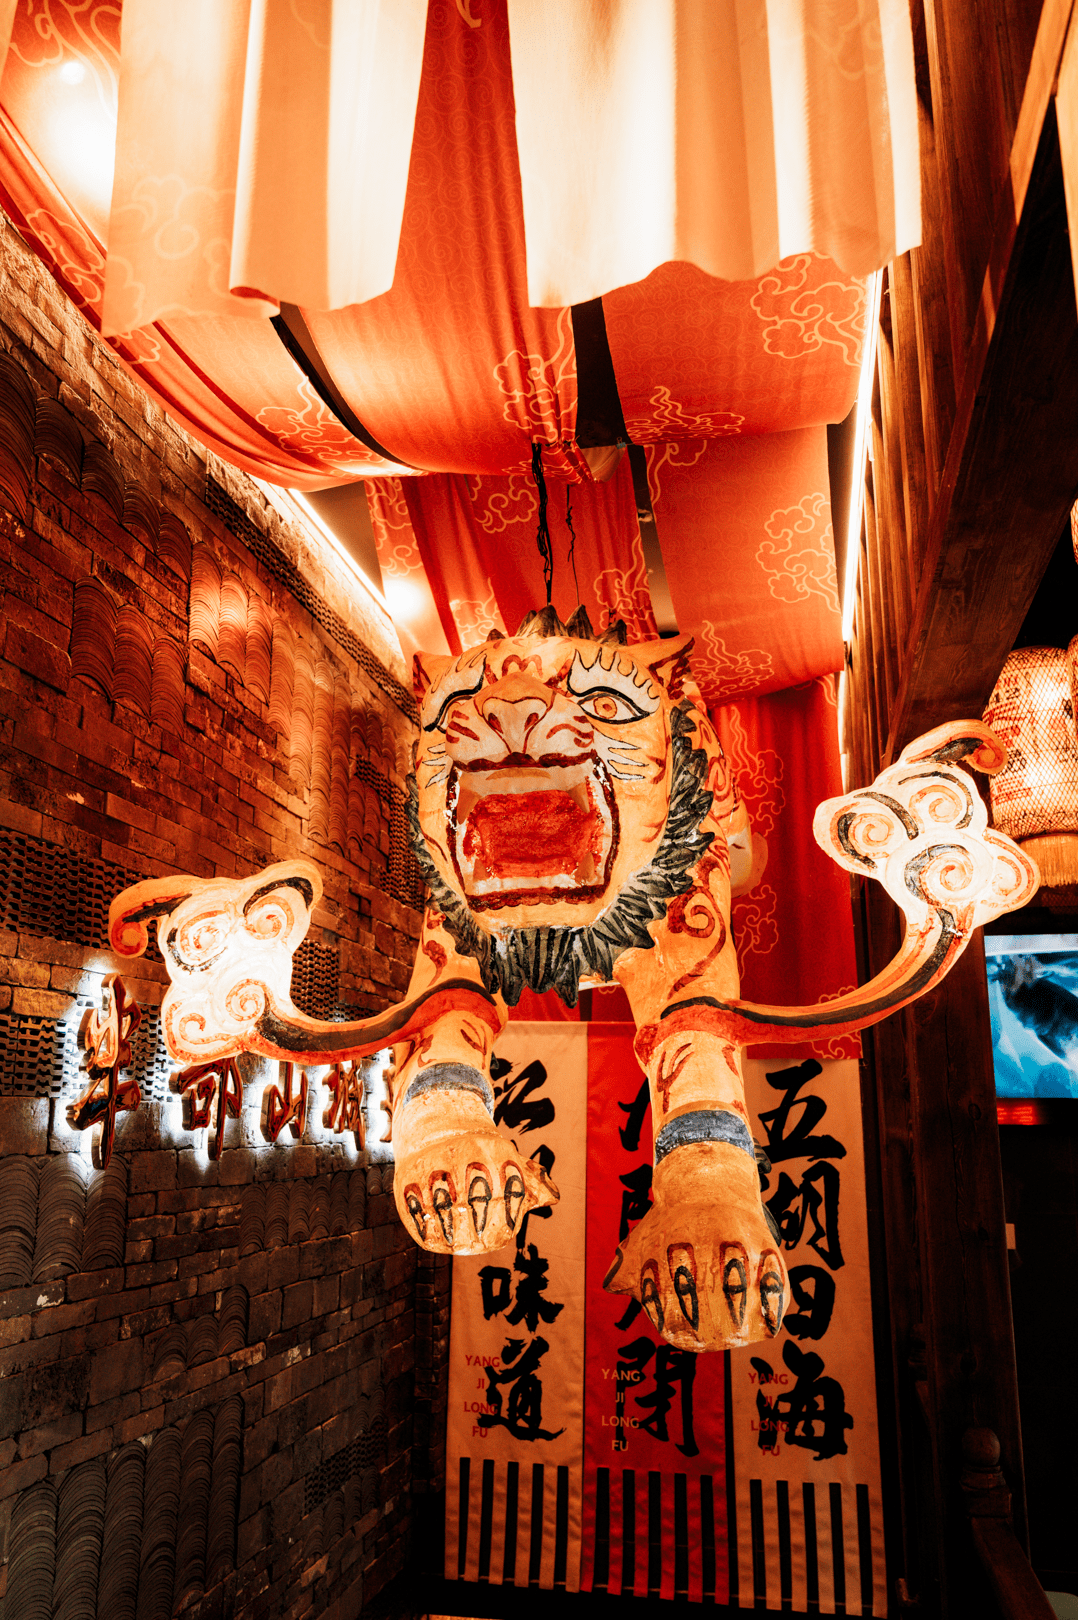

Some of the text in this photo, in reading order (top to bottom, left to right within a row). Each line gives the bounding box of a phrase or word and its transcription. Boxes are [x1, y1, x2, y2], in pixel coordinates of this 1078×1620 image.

[465, 1354, 500, 1368] YANG
[601, 1368, 641, 1382] YANG
[747, 1372, 789, 1385] YANG
[476, 1378, 485, 1389] JI
[615, 1391, 624, 1403] JI
[763, 1395, 773, 1407] JI
[464, 1401, 498, 1415] LONG
[601, 1415, 640, 1429] LONG
[750, 1419, 790, 1432] LONG
[472, 1425, 488, 1438] FU
[611, 1439, 629, 1452] FU
[762, 1444, 781, 1457] FU
